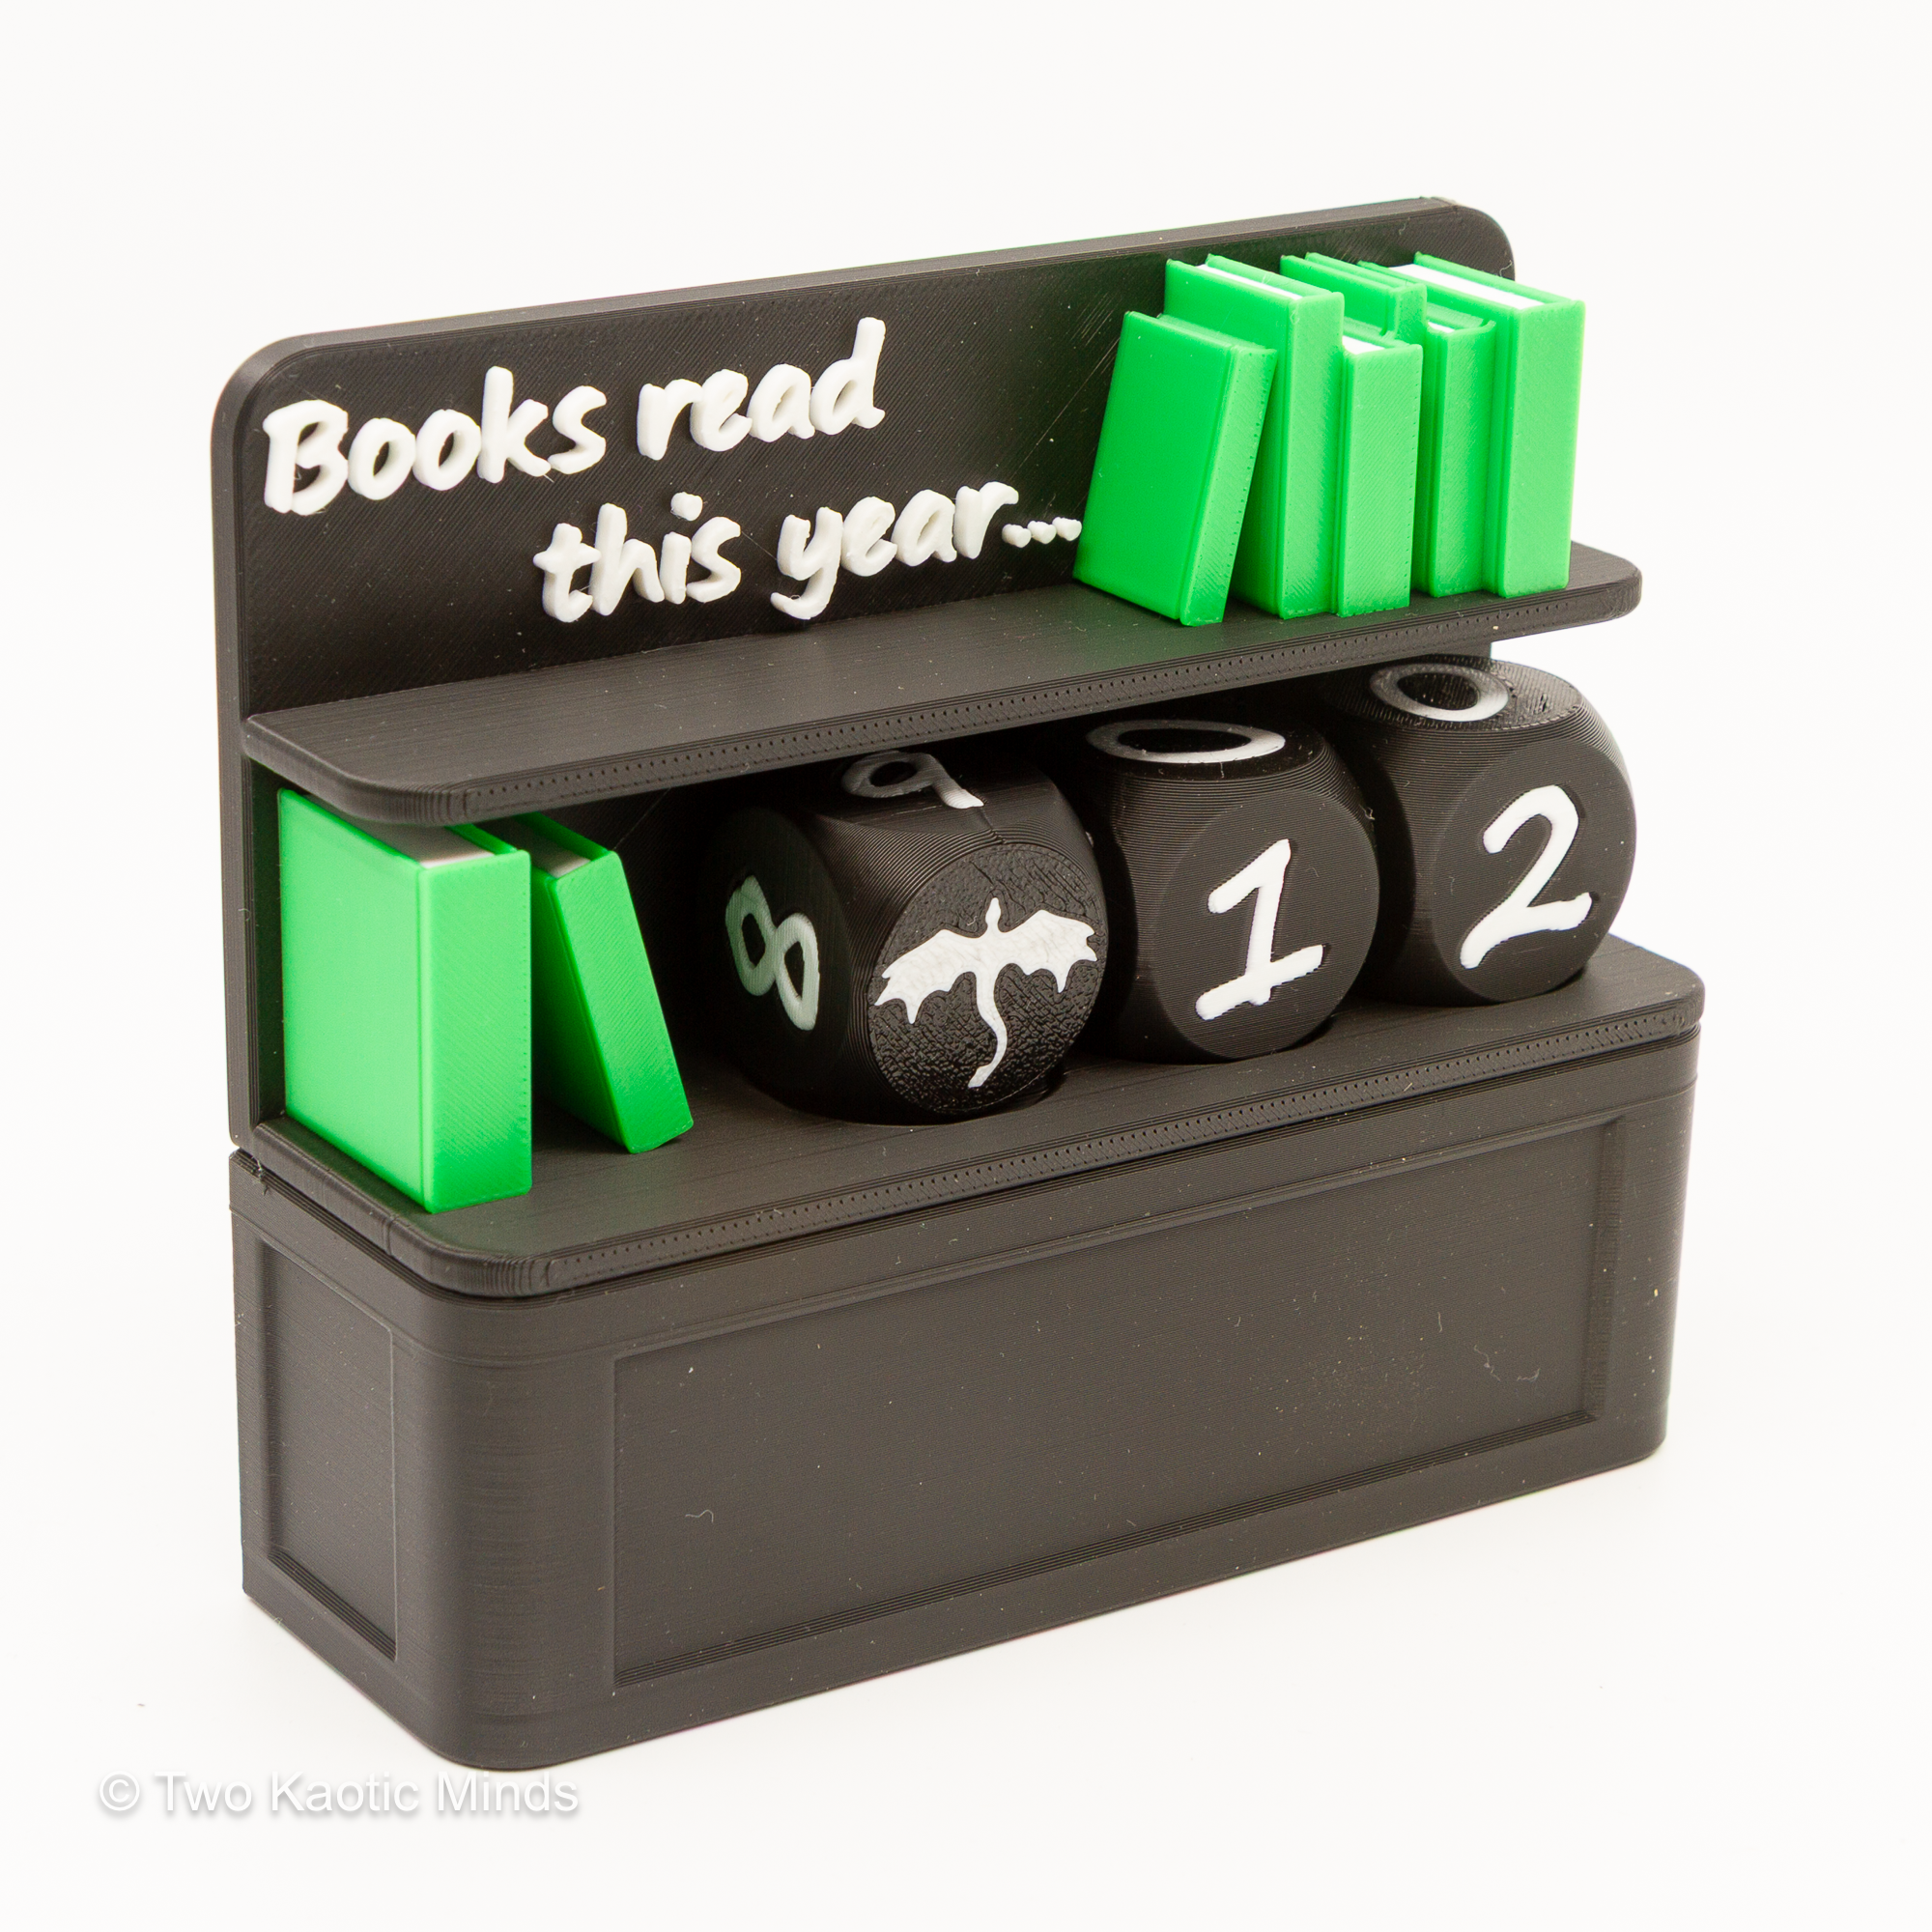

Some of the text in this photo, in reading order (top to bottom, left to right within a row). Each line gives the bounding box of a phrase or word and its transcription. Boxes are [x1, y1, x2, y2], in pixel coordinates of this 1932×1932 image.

[263, 316, 887, 517] Books read
[533, 480, 1083, 624] this year...
[840, 750, 984, 810] 9
[724, 873, 821, 1031] 8
[1195, 838, 1323, 1021] 1
[1459, 783, 1593, 970] 2
